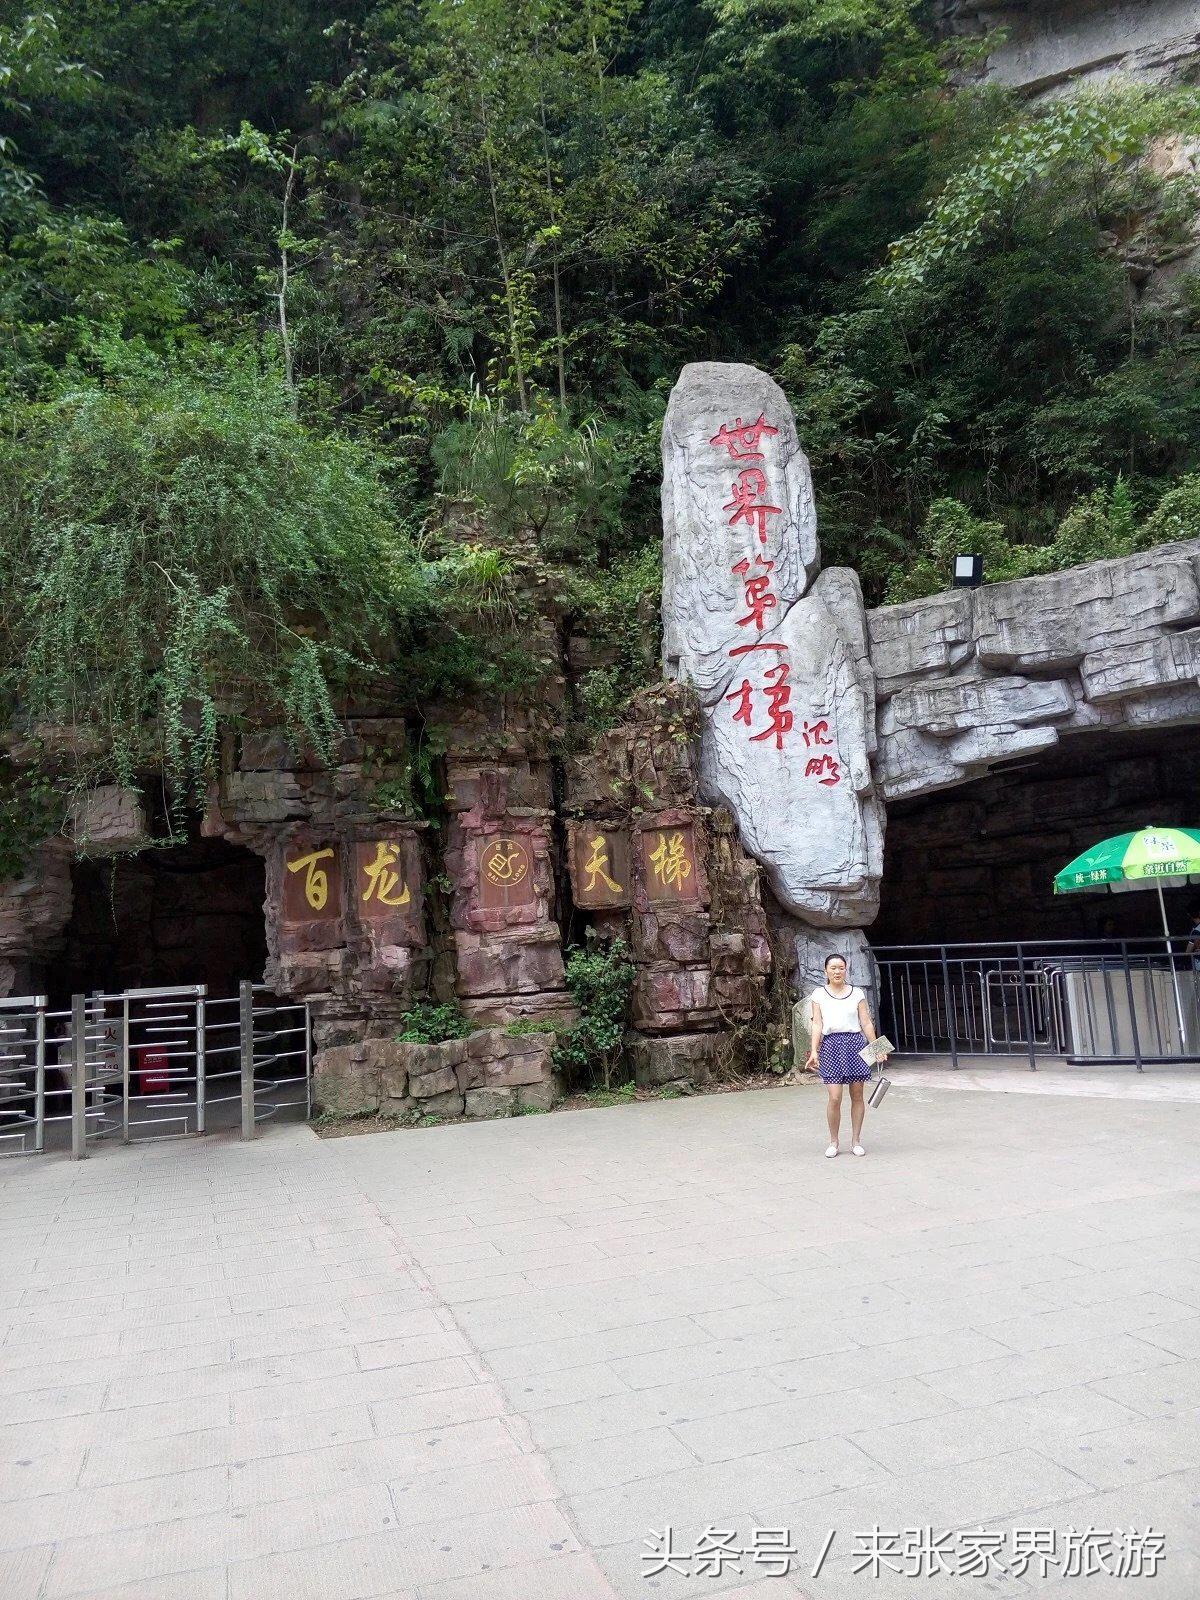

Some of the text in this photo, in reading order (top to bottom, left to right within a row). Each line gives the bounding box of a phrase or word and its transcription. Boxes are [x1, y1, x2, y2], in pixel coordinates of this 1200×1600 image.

[710, 413, 794, 750] 世界第一梯
[287, 835, 692, 911] 百龙 天梯
